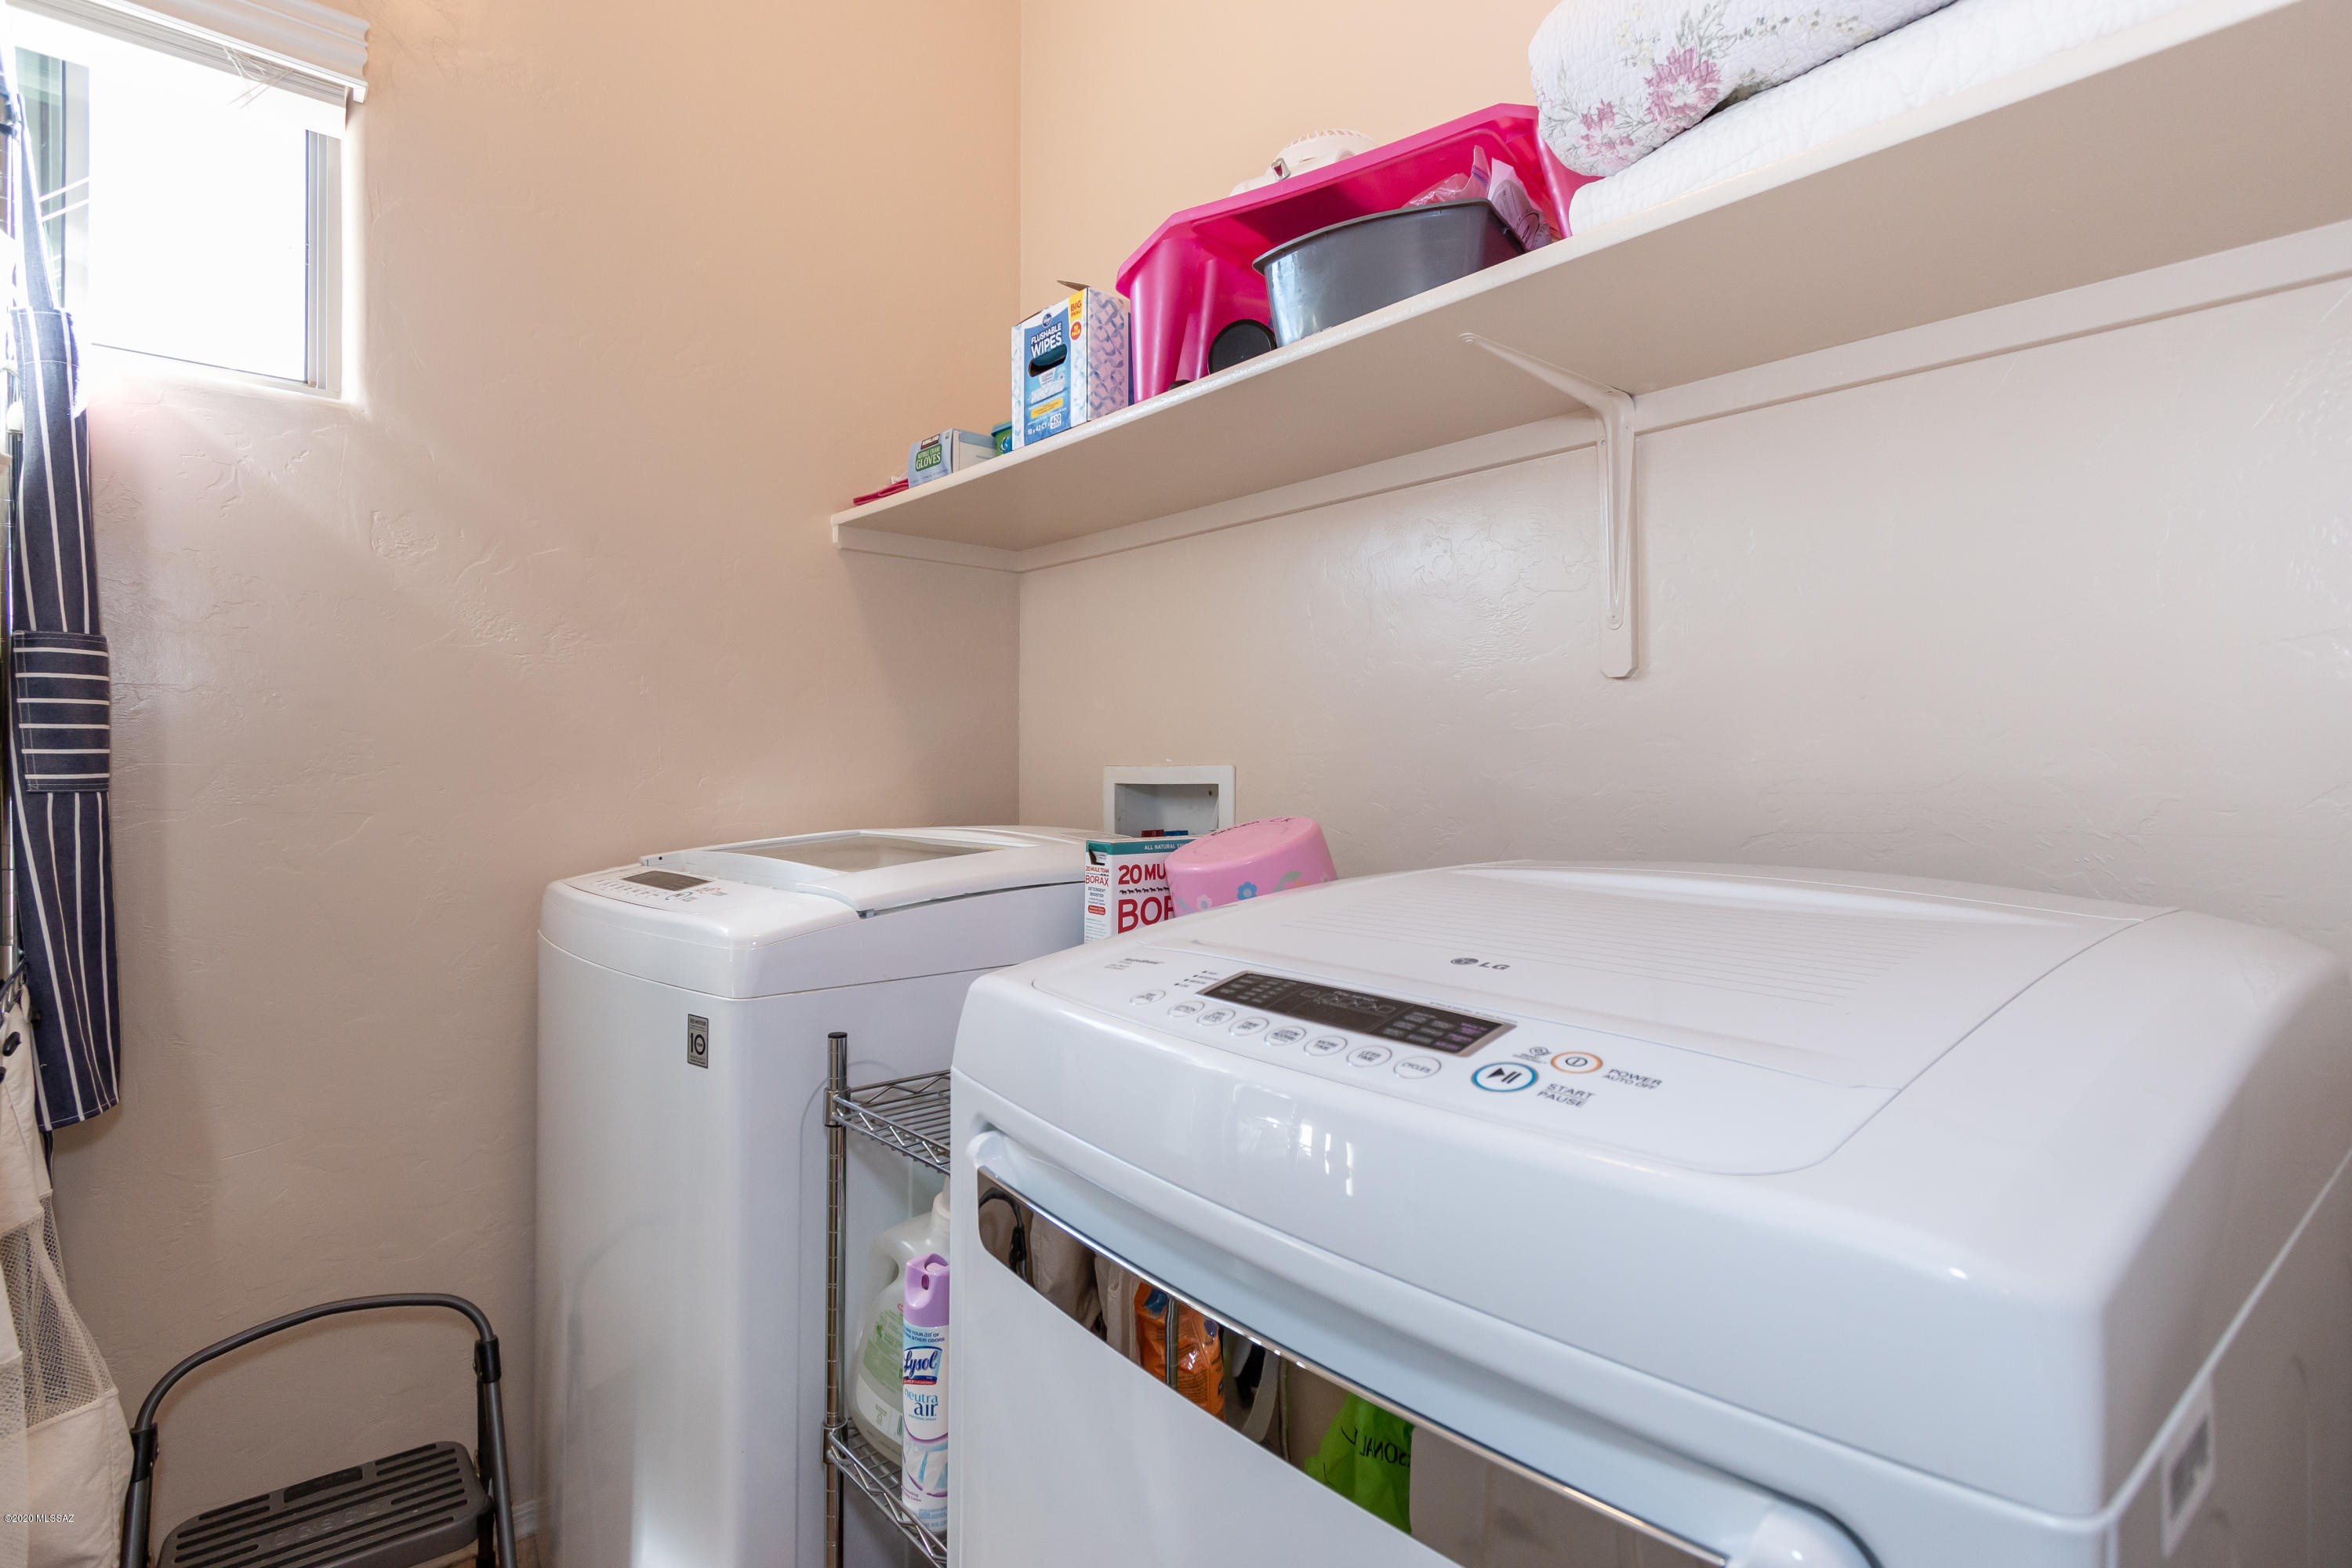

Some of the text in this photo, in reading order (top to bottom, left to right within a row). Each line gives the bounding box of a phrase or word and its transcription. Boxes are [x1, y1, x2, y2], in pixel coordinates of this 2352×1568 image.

[1071, 300, 1082, 311] BIG
[1031, 322, 1062, 345] FLUSHABLE
[1031, 332, 1062, 358] WIPES
[1051, 415, 1061, 423] 420
[916, 452, 941, 470] GLOVES
[1085, 874, 1109, 887] BORAX
[1118, 864, 1142, 885] 20
[1479, 962, 1511, 971] LG
[690, 1033, 706, 1055] 10
[1401, 1062, 1432, 1074] CYCLES
[1602, 1074, 1657, 1091] AUTO OFF
[1608, 1069, 1662, 1086] POWER
[1537, 1091, 1586, 1108] PAUSE
[1547, 1083, 1596, 1099] START
[904, 1350, 938, 1378] Lysol
[904, 1388, 938, 1403] neutra
[914, 1402, 938, 1417] air
